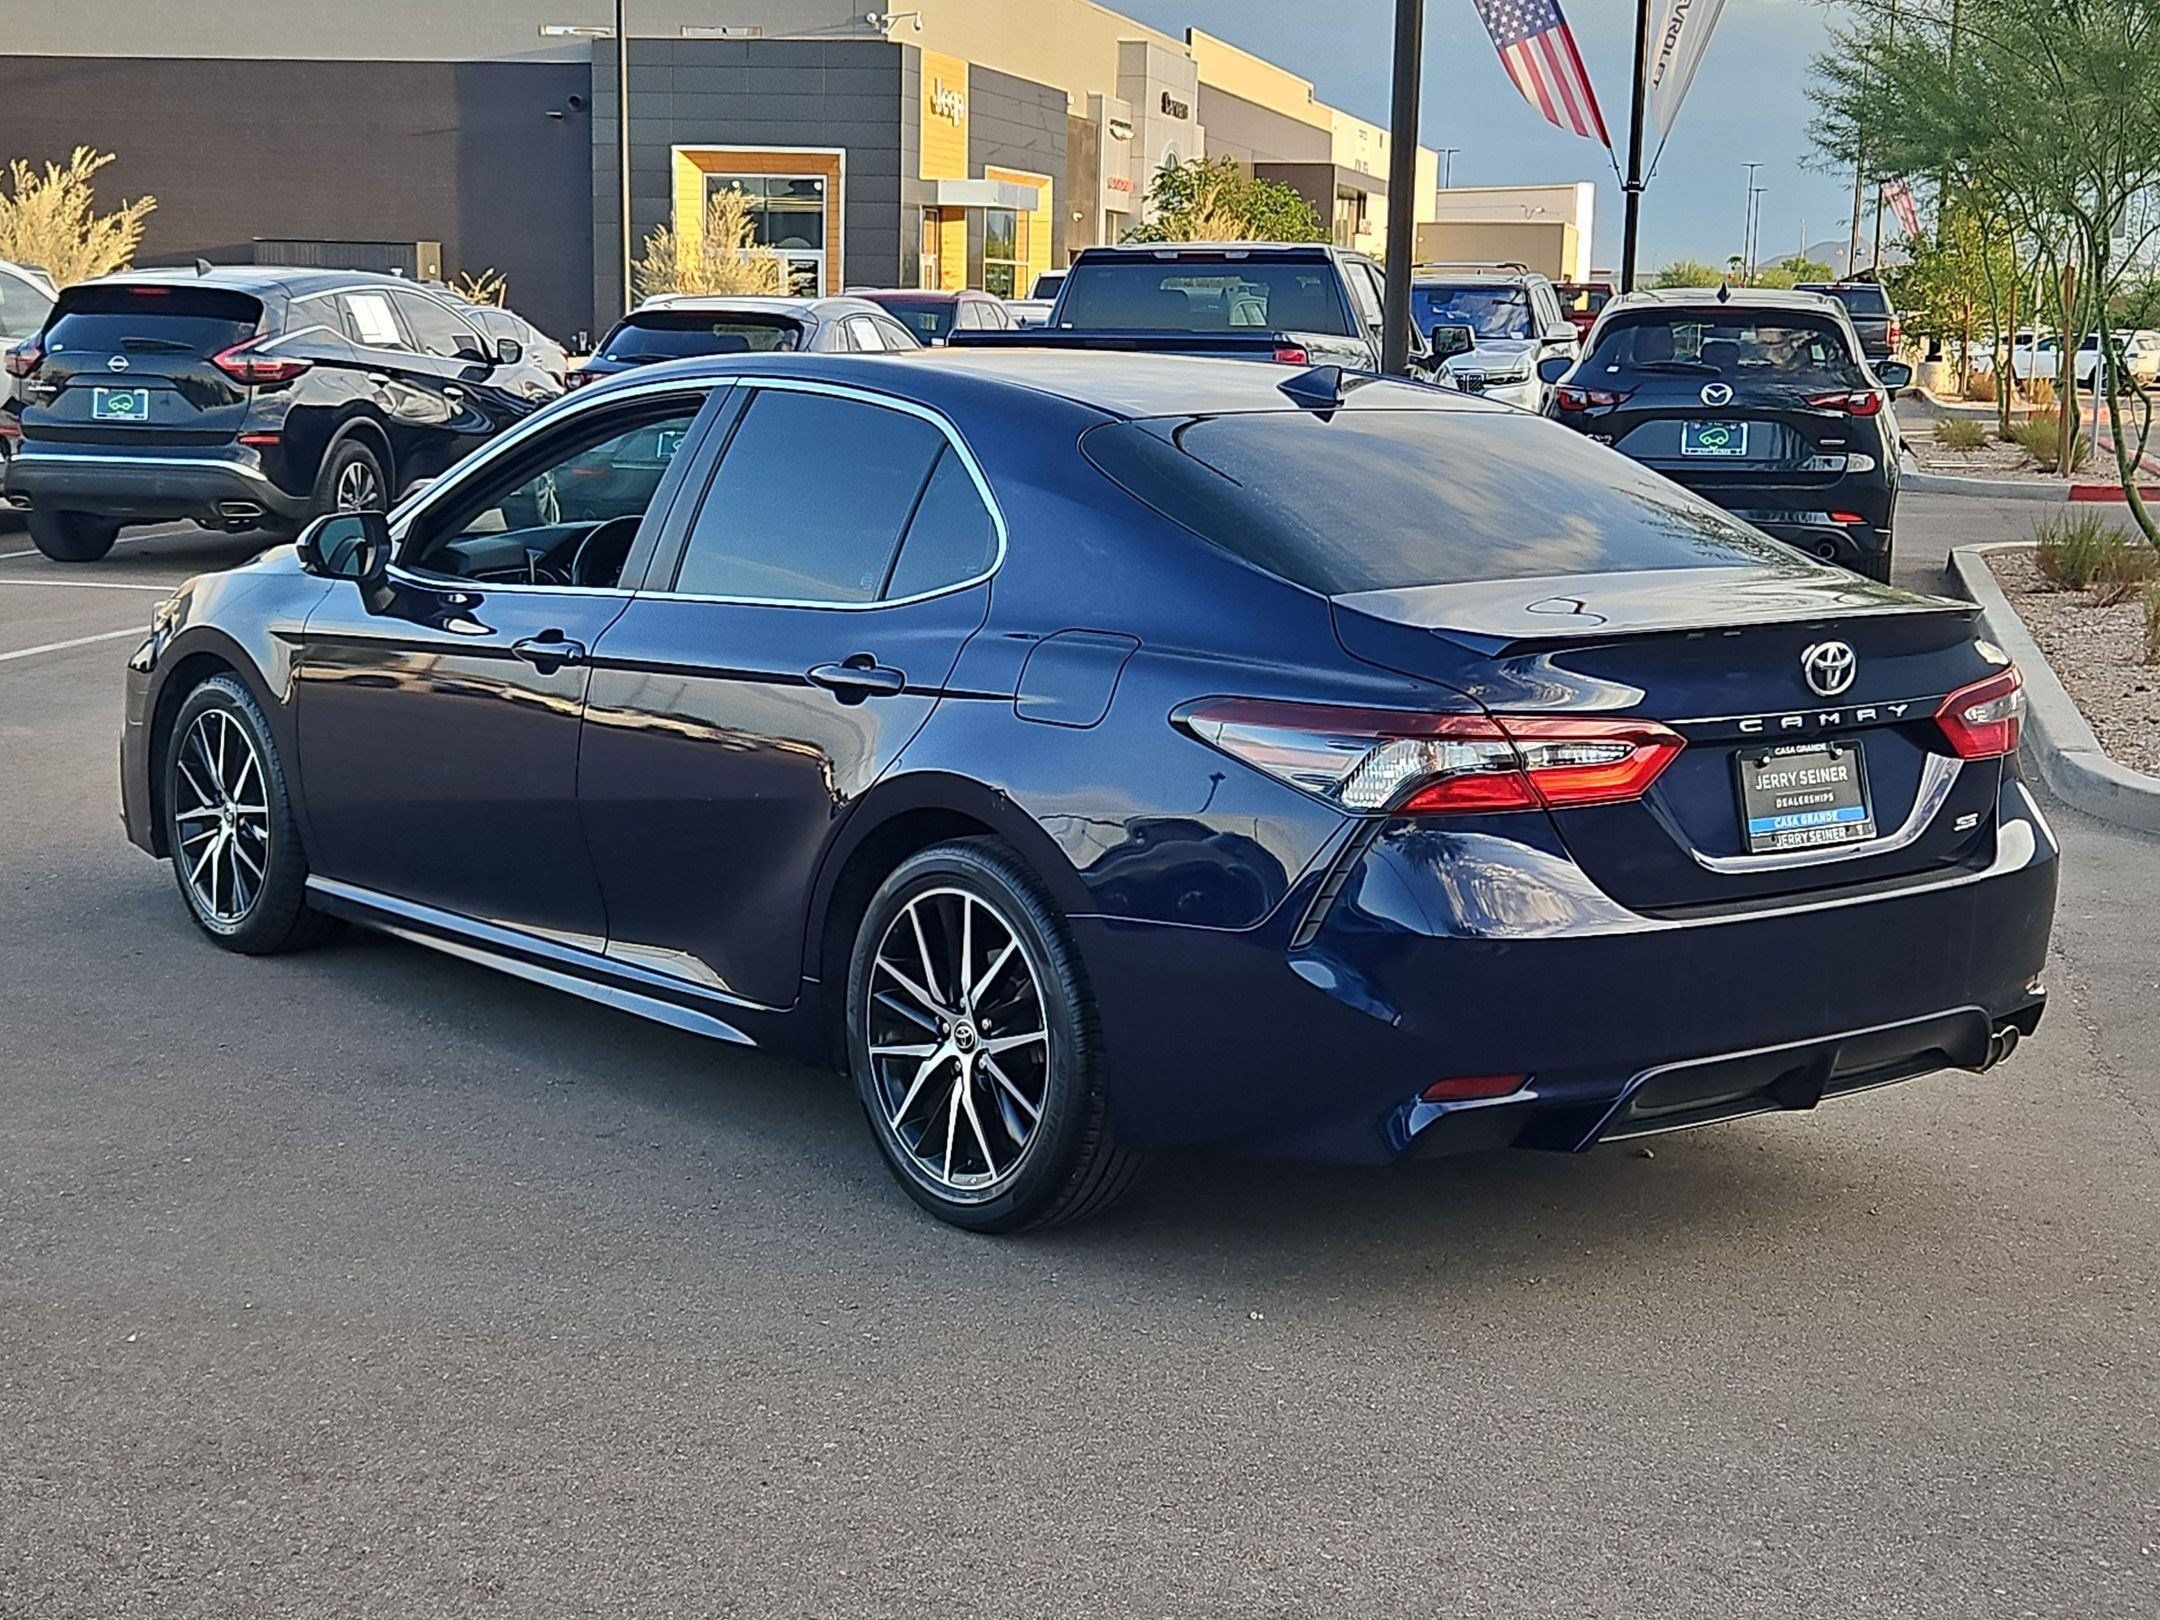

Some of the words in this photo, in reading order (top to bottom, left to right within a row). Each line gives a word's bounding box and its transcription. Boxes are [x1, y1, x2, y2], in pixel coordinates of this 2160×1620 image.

[930, 77, 965, 128] Jeep
[1739, 704, 1908, 732] CAMRY
[1774, 745, 1796, 755] CASA
[1796, 742, 1827, 754] GRANDE
[1755, 770, 1797, 790] JERRY
[1800, 765, 1848, 785] SEINER
[1776, 792, 1834, 808] DEALERSHIPS
[1774, 816, 1799, 828] CASA
[1800, 810, 1839, 823] GRANDE
[1776, 832, 1808, 847] JERRY
[1808, 827, 1847, 843] SEINER
